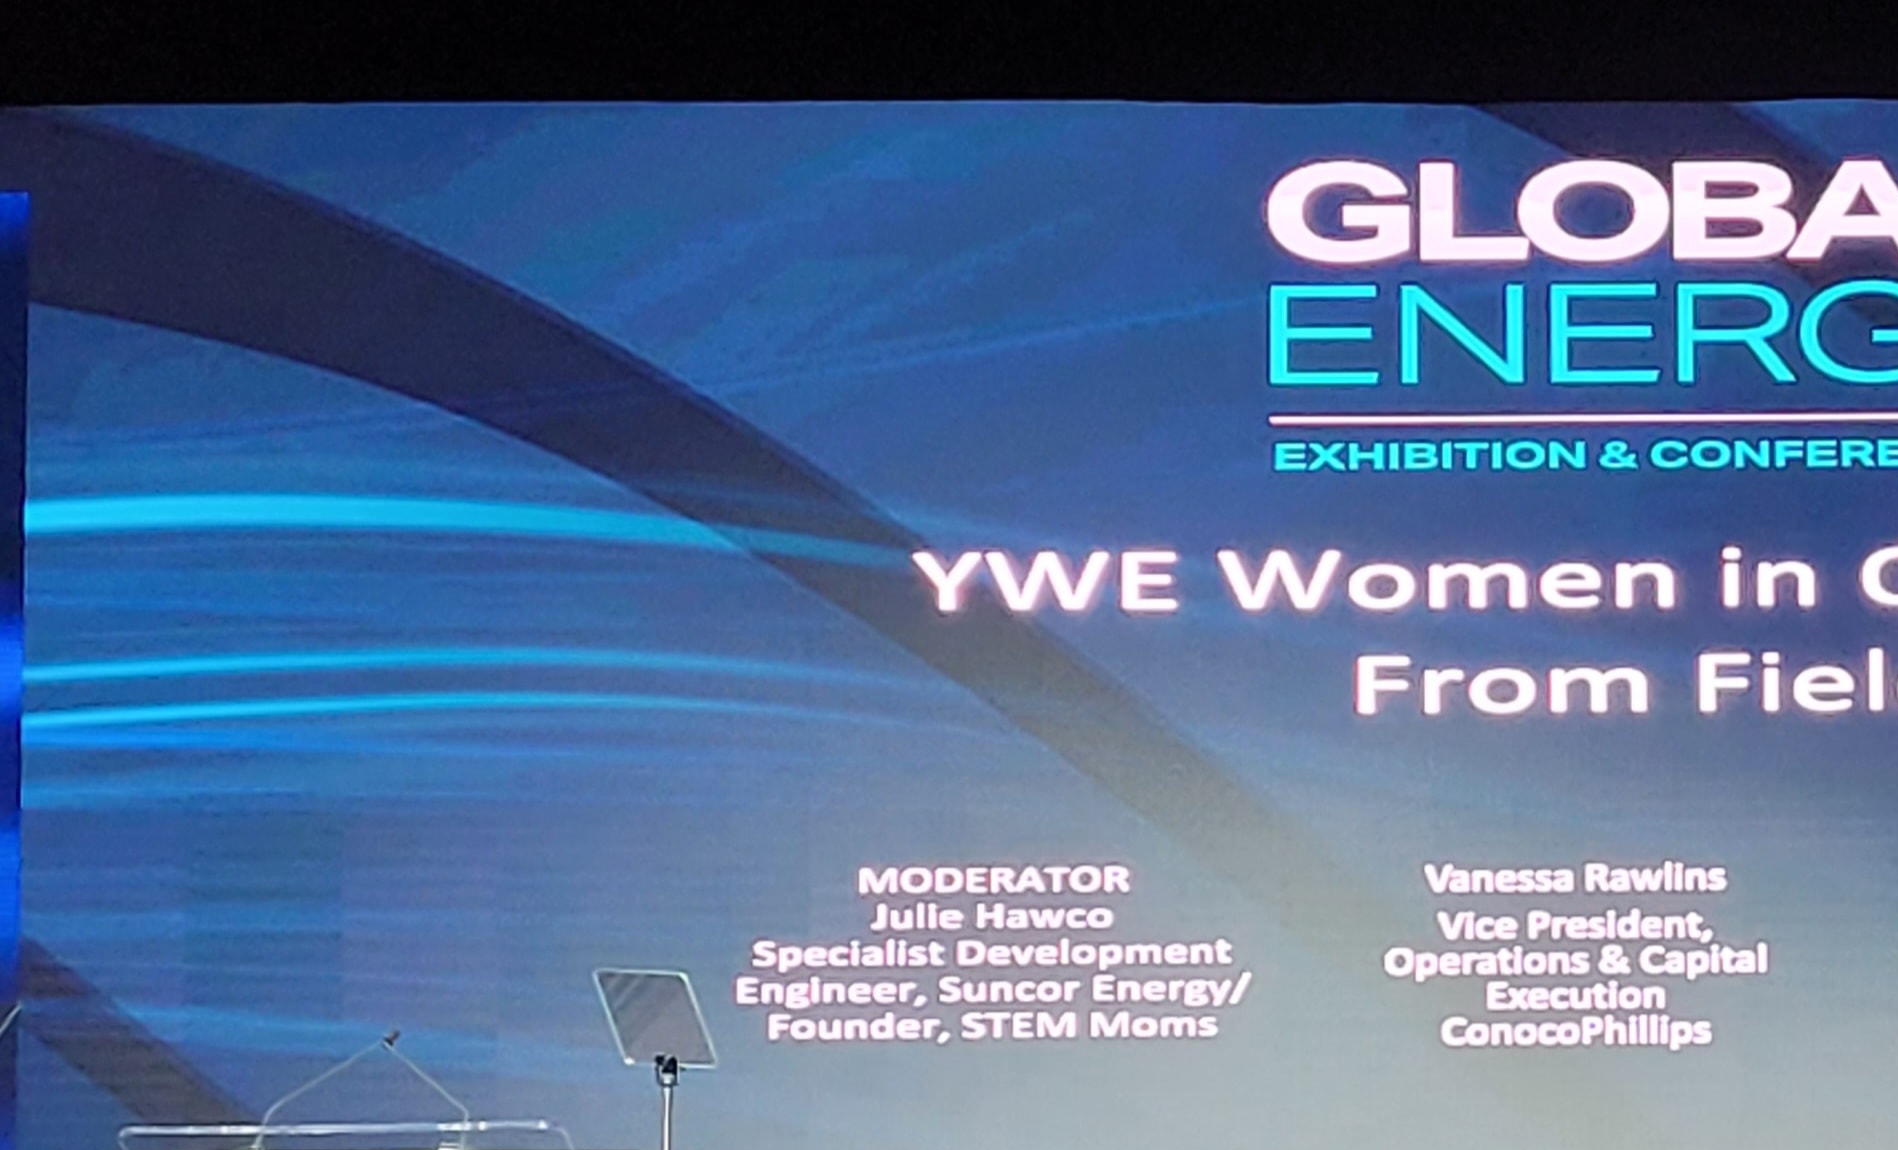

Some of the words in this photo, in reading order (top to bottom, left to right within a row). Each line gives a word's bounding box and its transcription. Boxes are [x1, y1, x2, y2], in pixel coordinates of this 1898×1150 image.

[1274, 440, 1586, 471] EXHIBITION
[1599, 440, 1638, 469] &
[910, 549, 1180, 612] YWE
[1217, 549, 1674, 610] Women
[1722, 547, 1815, 607] in
[1357, 655, 1648, 715] From
[858, 865, 1131, 894] MODERATOR
[1424, 863, 1574, 894] Vanessa
[1584, 860, 1728, 892] Rawlins
[870, 902, 965, 931] Julie
[976, 903, 1114, 929] Hawco
[1436, 911, 1519, 941] Vice
[1527, 908, 1718, 946] President,
[752, 938, 946, 973] Specialist
[957, 937, 1233, 971] Development
[1384, 945, 1590, 984] Operations
[1597, 944, 1632, 975] &
[1639, 939, 1768, 981] Capital
[736, 976, 927, 1009] Engineer,
[938, 976, 1082, 1003] Suncor
[1092, 971, 1253, 1007] Energy/
[1486, 979, 1666, 1011] Execution
[768, 1011, 951, 1044] Founder,
[961, 1011, 1077, 1039] STEM
[1090, 1010, 1219, 1038] Moms
[1440, 1013, 1713, 1051] ConocoPhillips
